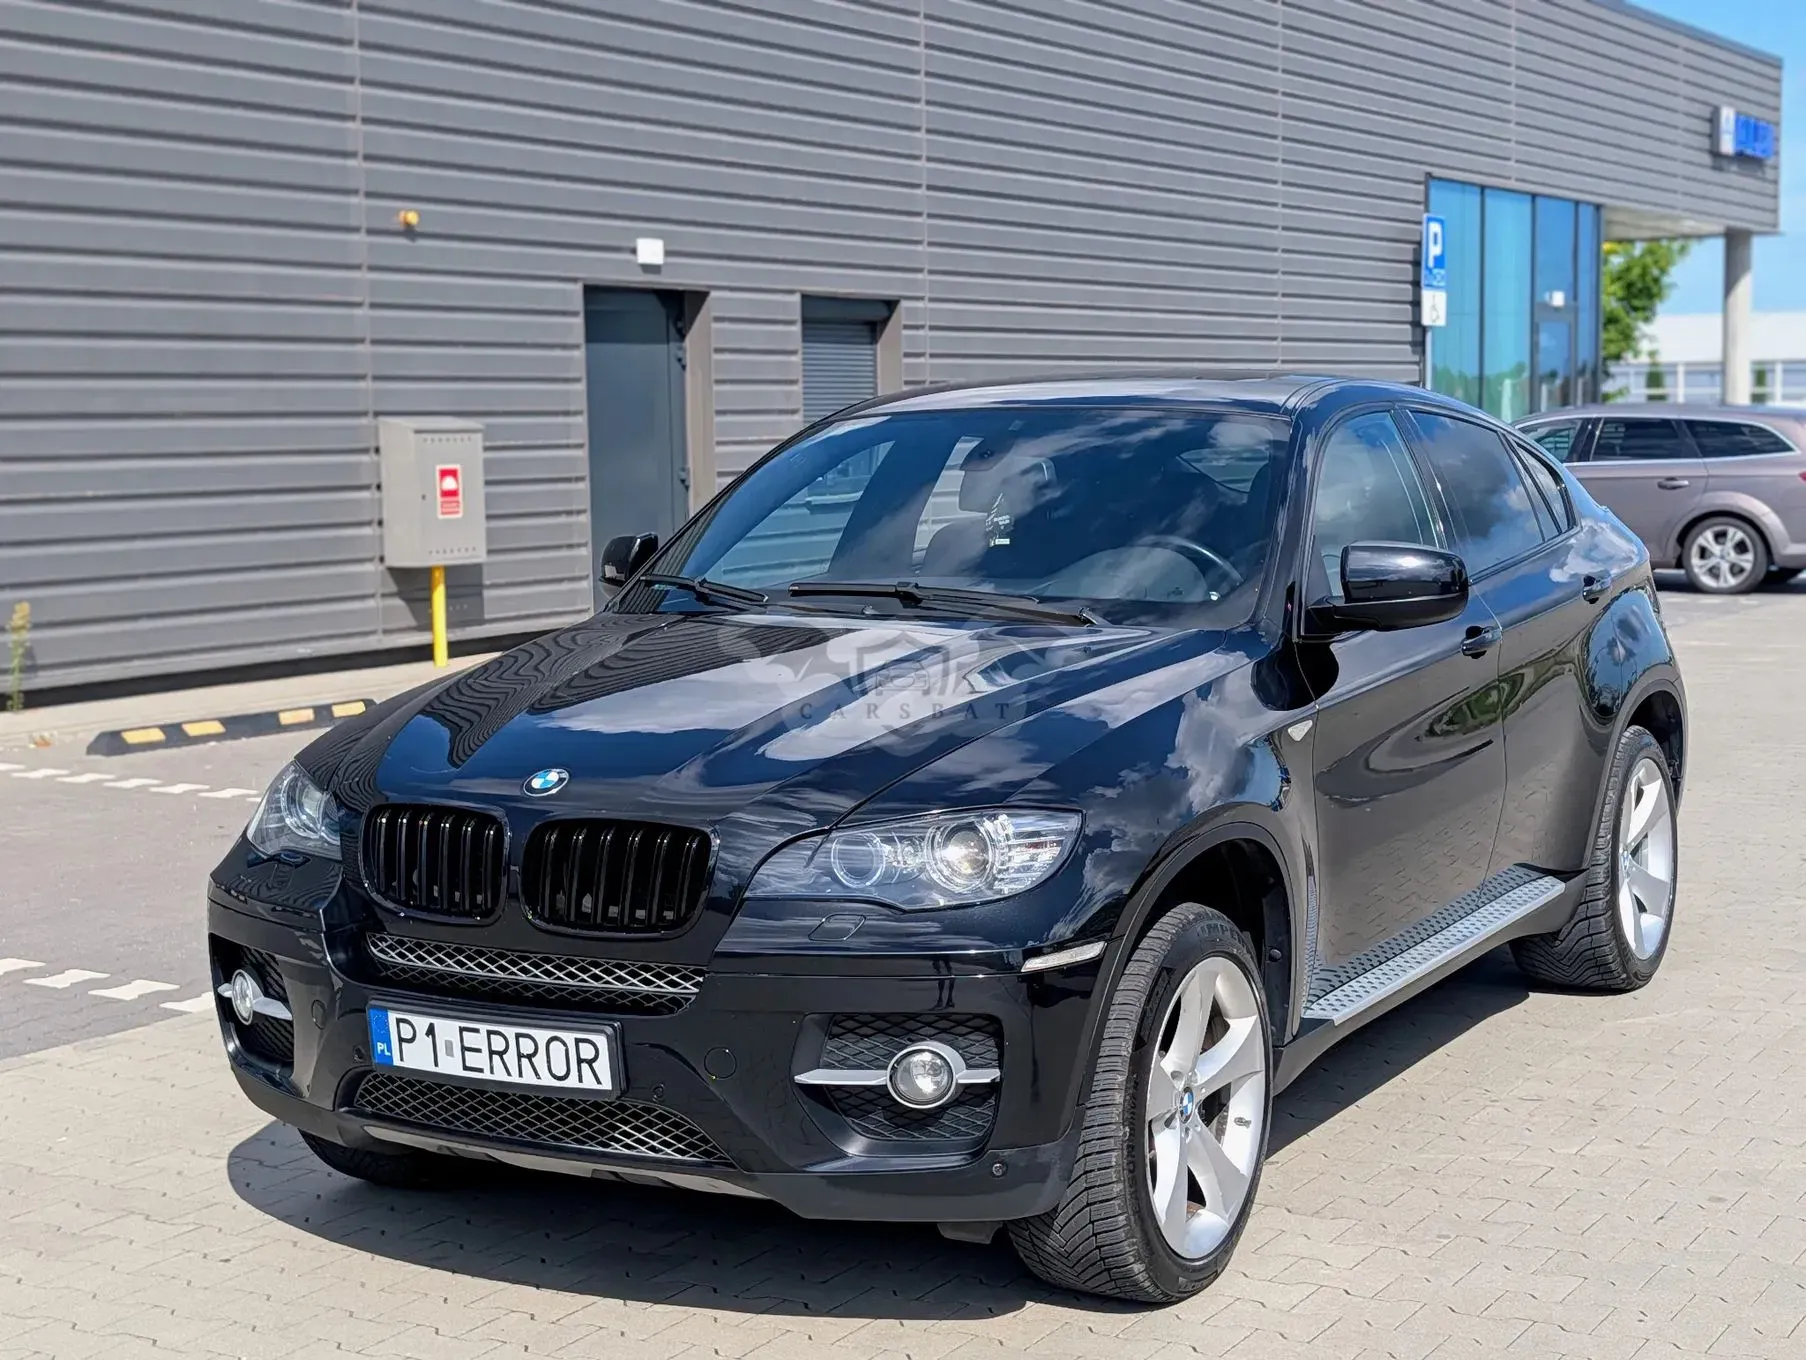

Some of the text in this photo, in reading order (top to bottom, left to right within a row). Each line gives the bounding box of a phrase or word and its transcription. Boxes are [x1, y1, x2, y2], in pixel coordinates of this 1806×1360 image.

[1428, 221, 1443, 268] P
[376, 1041, 391, 1057] PL
[395, 1017, 603, 1085] P1 ERROR
